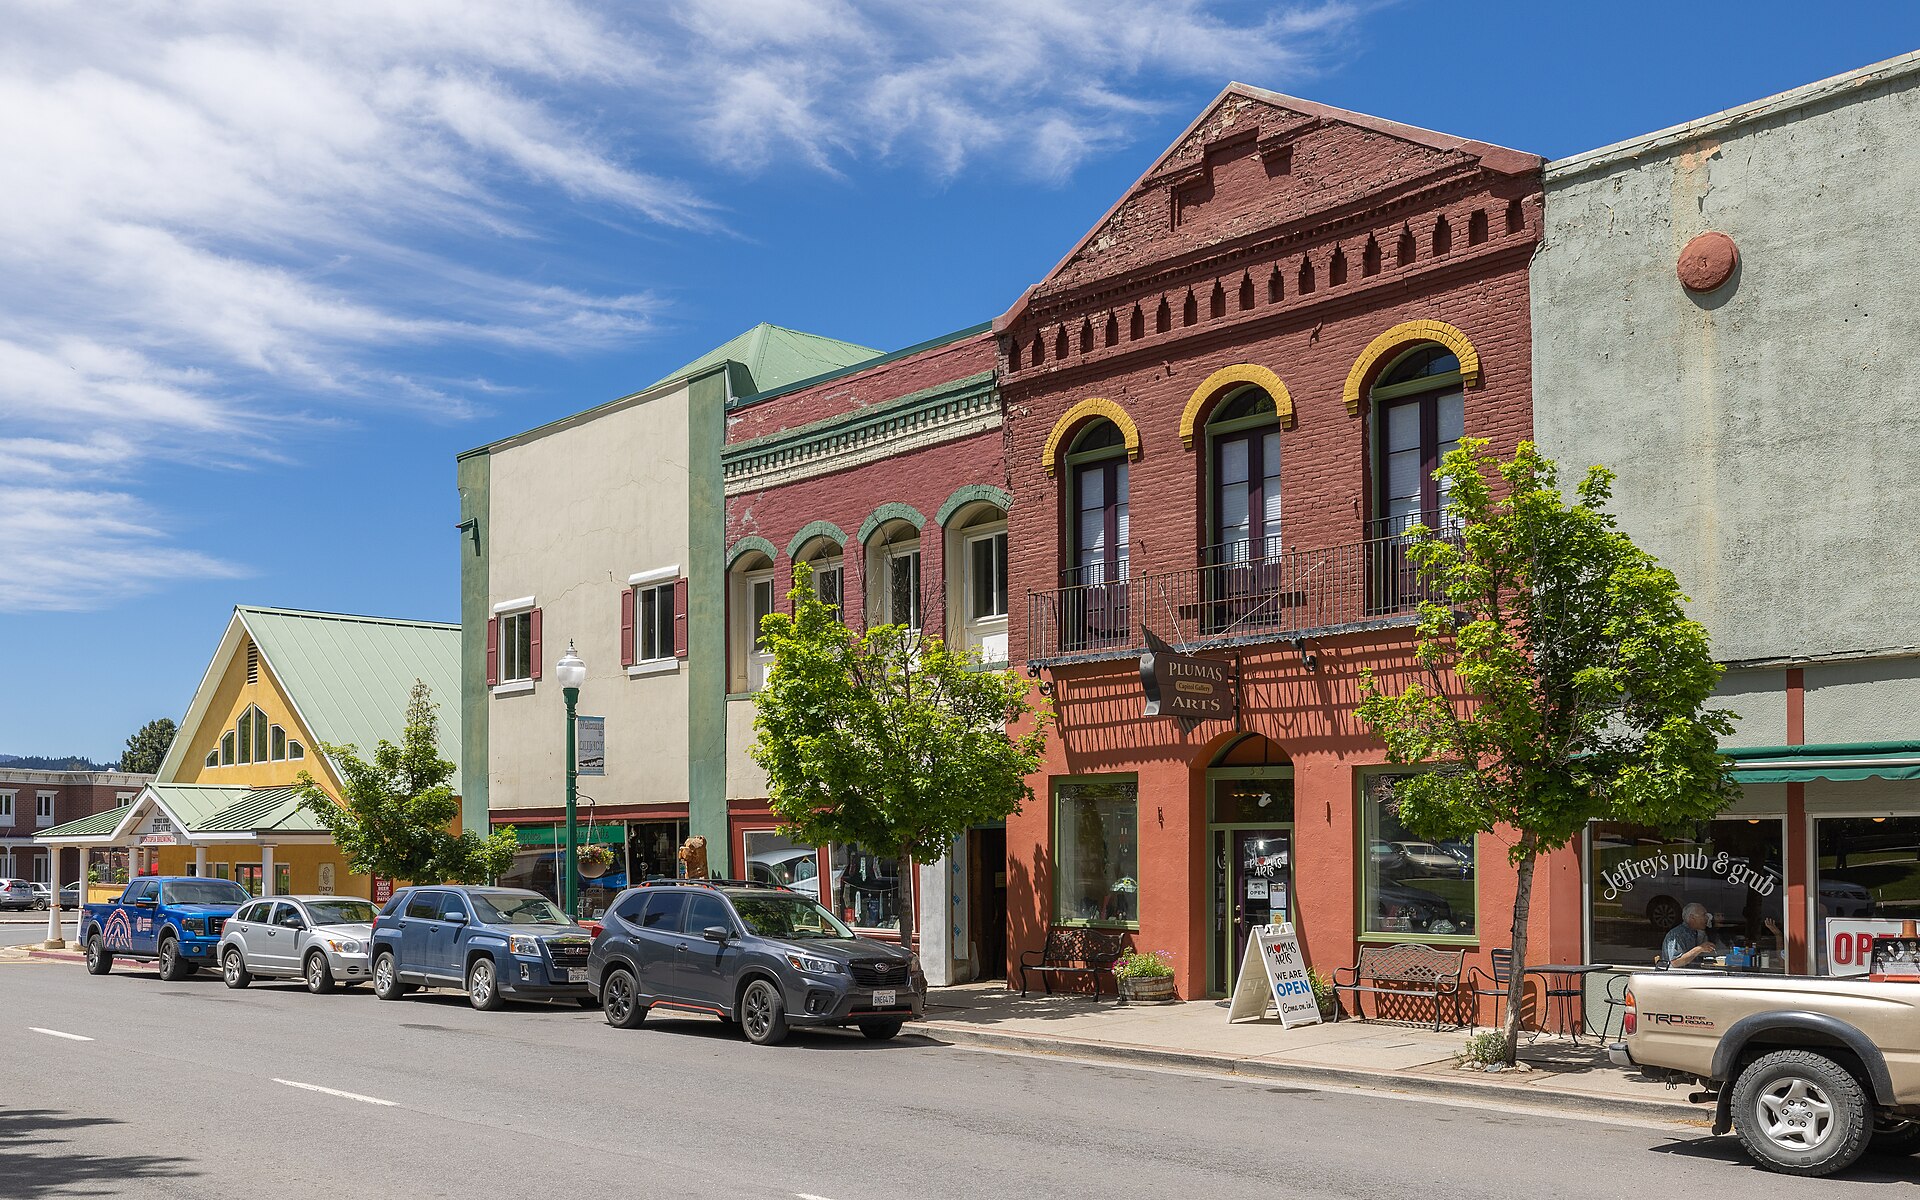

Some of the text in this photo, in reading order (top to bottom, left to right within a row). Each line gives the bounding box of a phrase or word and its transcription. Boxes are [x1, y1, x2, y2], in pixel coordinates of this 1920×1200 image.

[1169, 662, 1222, 681] PLUMAS
[1195, 684, 1210, 693] Gallery
[1172, 696, 1220, 711] ARTS
[579, 721, 604, 730] Welcome
[152, 824, 171, 832] THEATRE
[1255, 865, 1274, 877] ARTS
[1601, 848, 1775, 900] Jeffrey's pub & grub
[1275, 951, 1293, 965] ARTS
[1275, 969, 1303, 980] WE ARE
[1276, 980, 1310, 996] OPEN
[1282, 1003, 1299, 1013] Come
[1642, 1012, 1684, 1026] TRD
